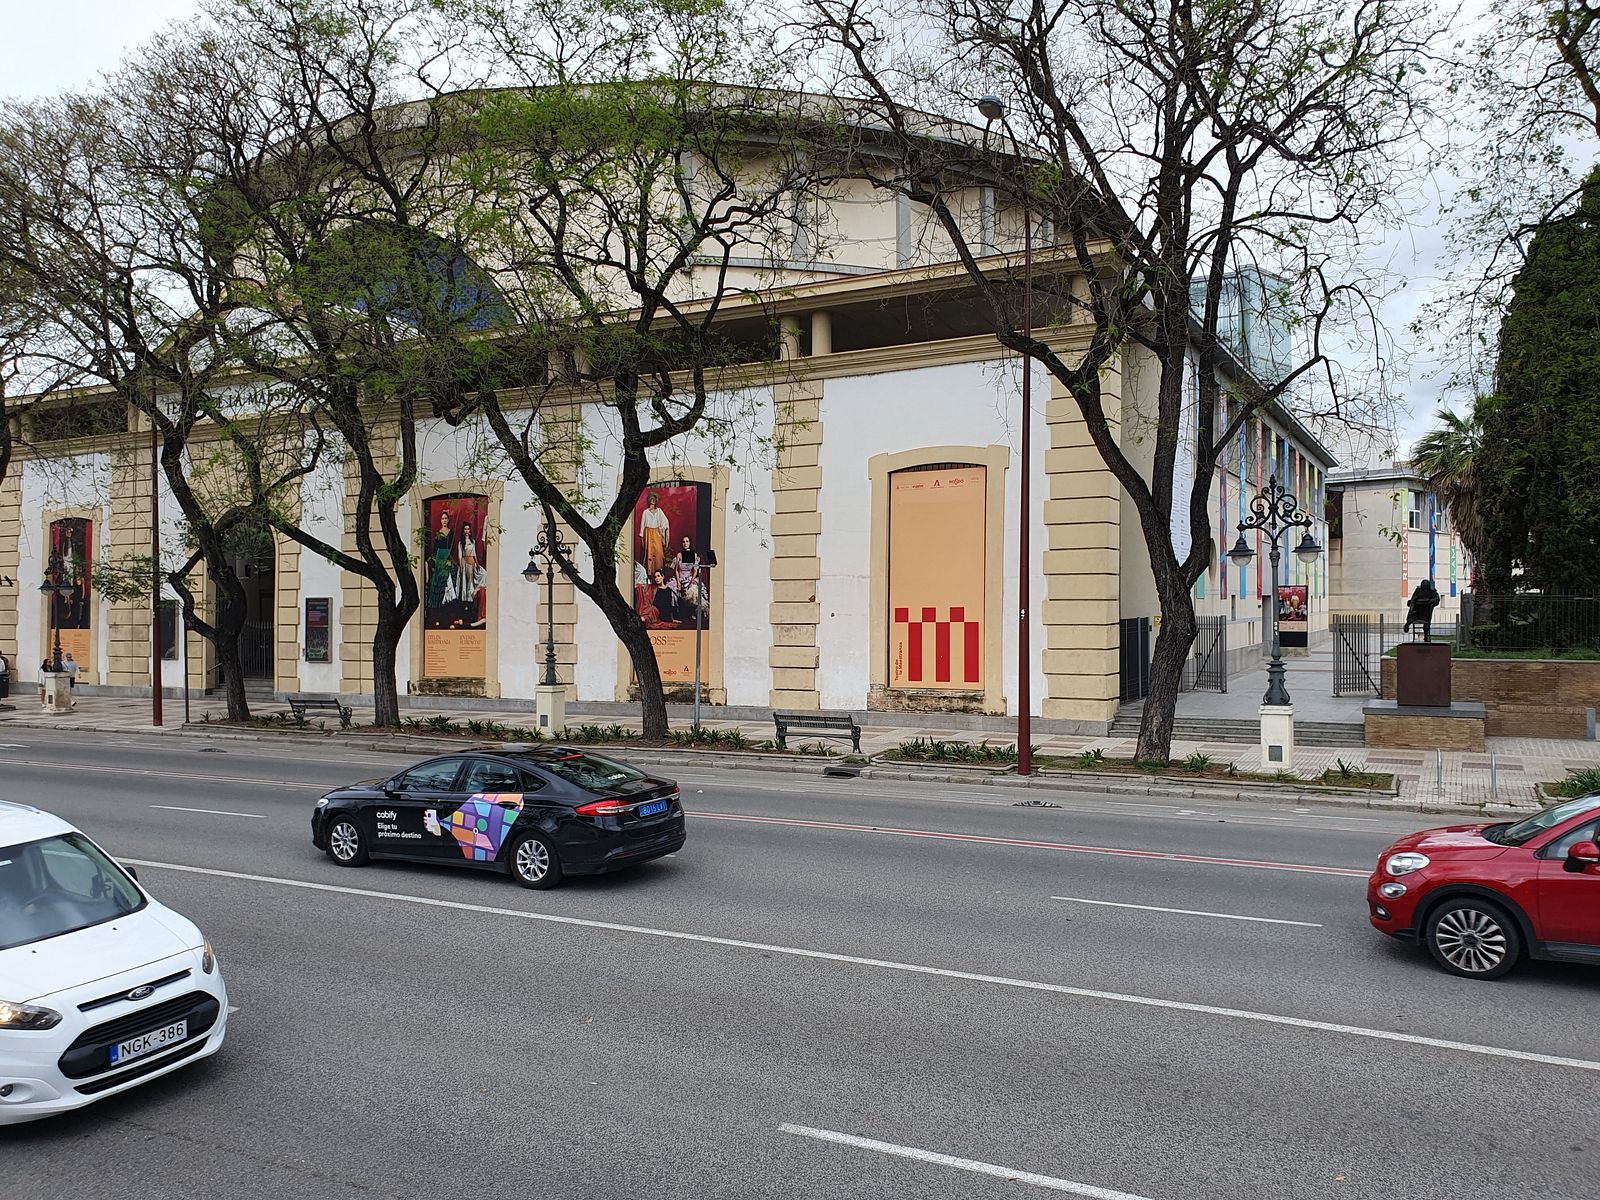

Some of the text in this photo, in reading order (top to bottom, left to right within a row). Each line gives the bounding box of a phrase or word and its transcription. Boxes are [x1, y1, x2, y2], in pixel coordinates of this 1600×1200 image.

[376, 810, 397, 821] cabify
[377, 822, 391, 830] Elige
[401, 831, 422, 839] destino
[121, 1023, 184, 1058] NGK-386
